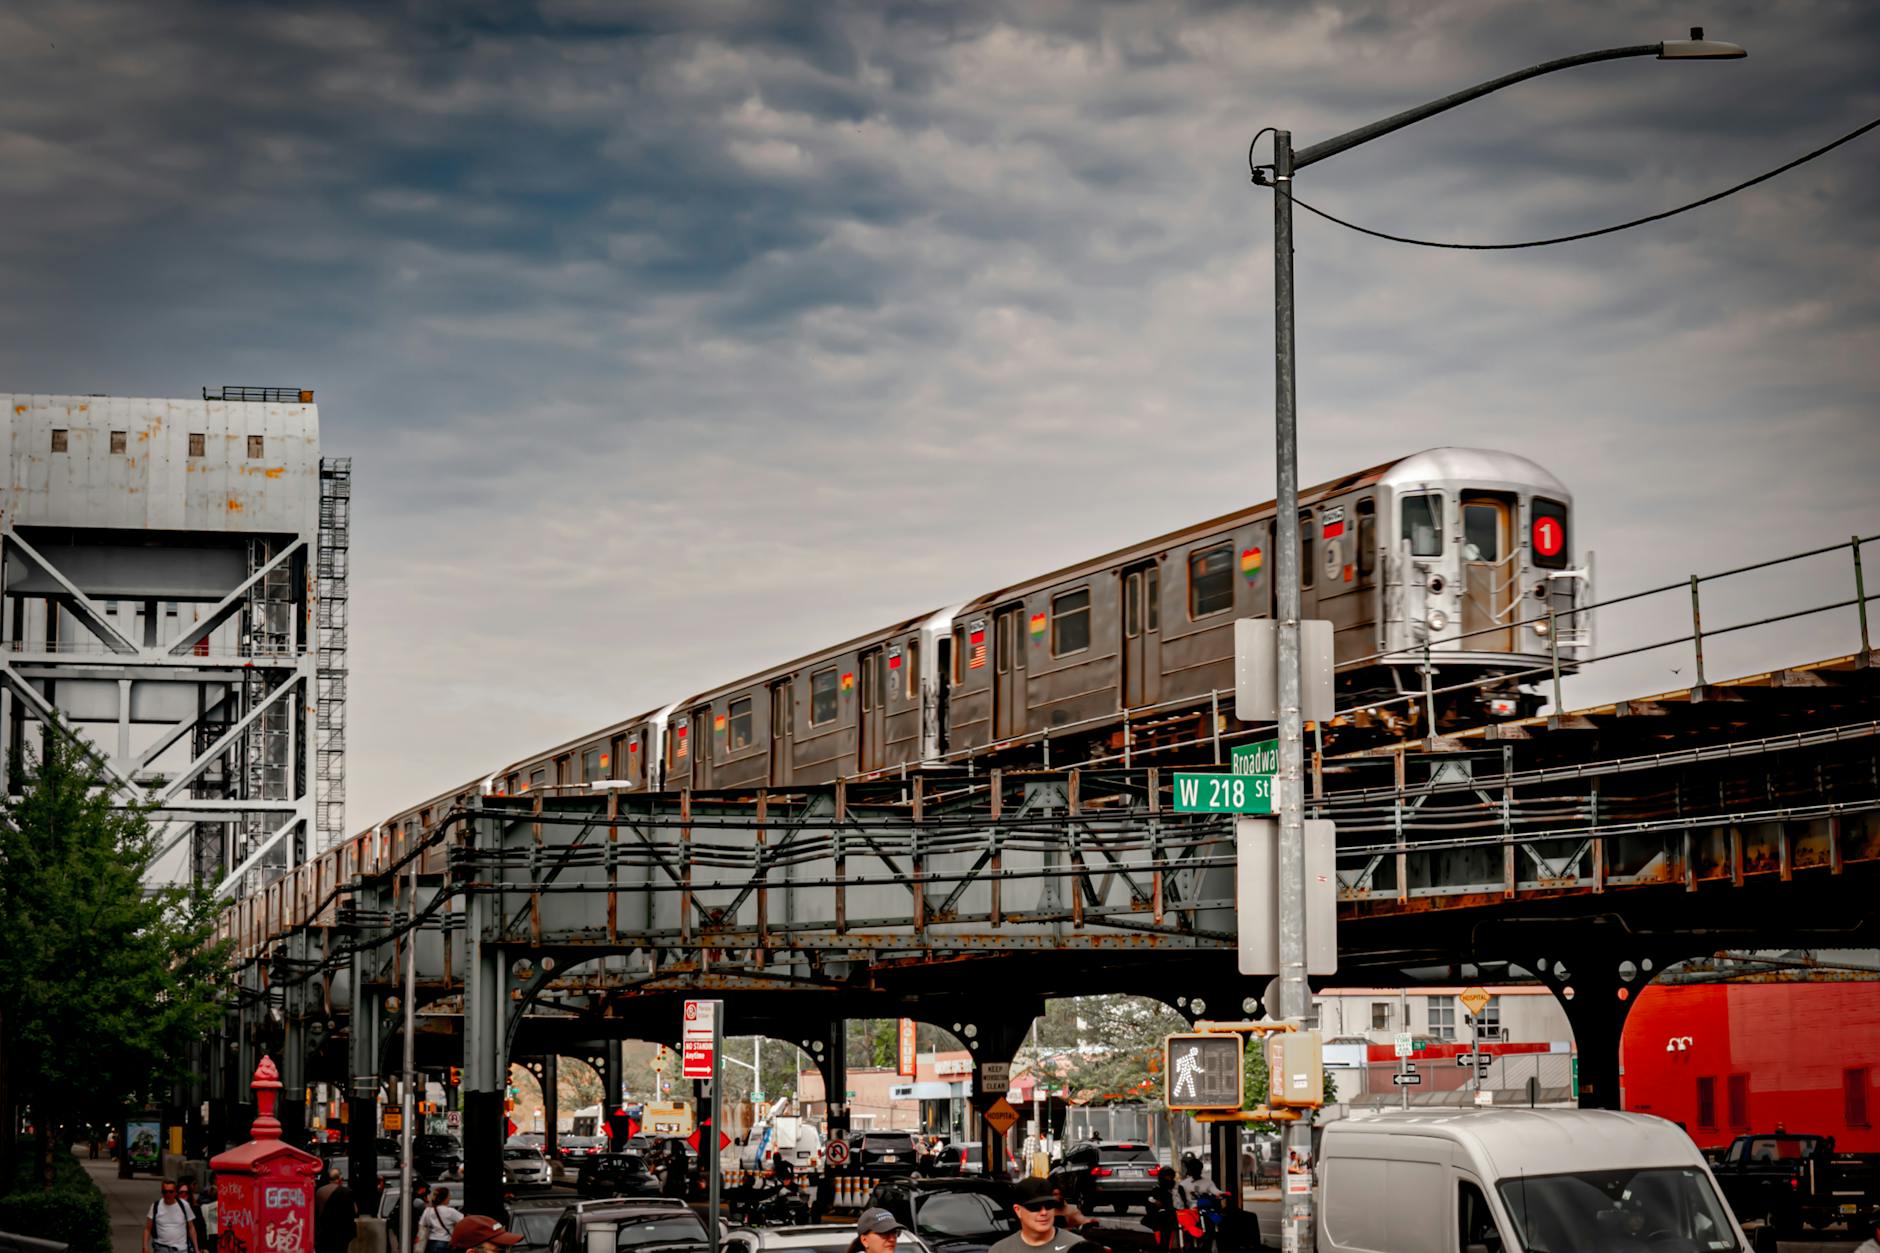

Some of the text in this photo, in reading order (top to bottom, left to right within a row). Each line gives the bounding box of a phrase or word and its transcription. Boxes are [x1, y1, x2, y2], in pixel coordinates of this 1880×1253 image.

[1538, 523, 1552, 549] 1
[1233, 746, 1279, 775] Broadway
[1179, 778, 1269, 808] W 218 St
[685, 1042, 713, 1050] NO STANDIN
[685, 1051, 705, 1061] Anytime
[987, 1065, 1003, 1073] KEEP
[987, 1111, 1016, 1120] HOSPITAL
